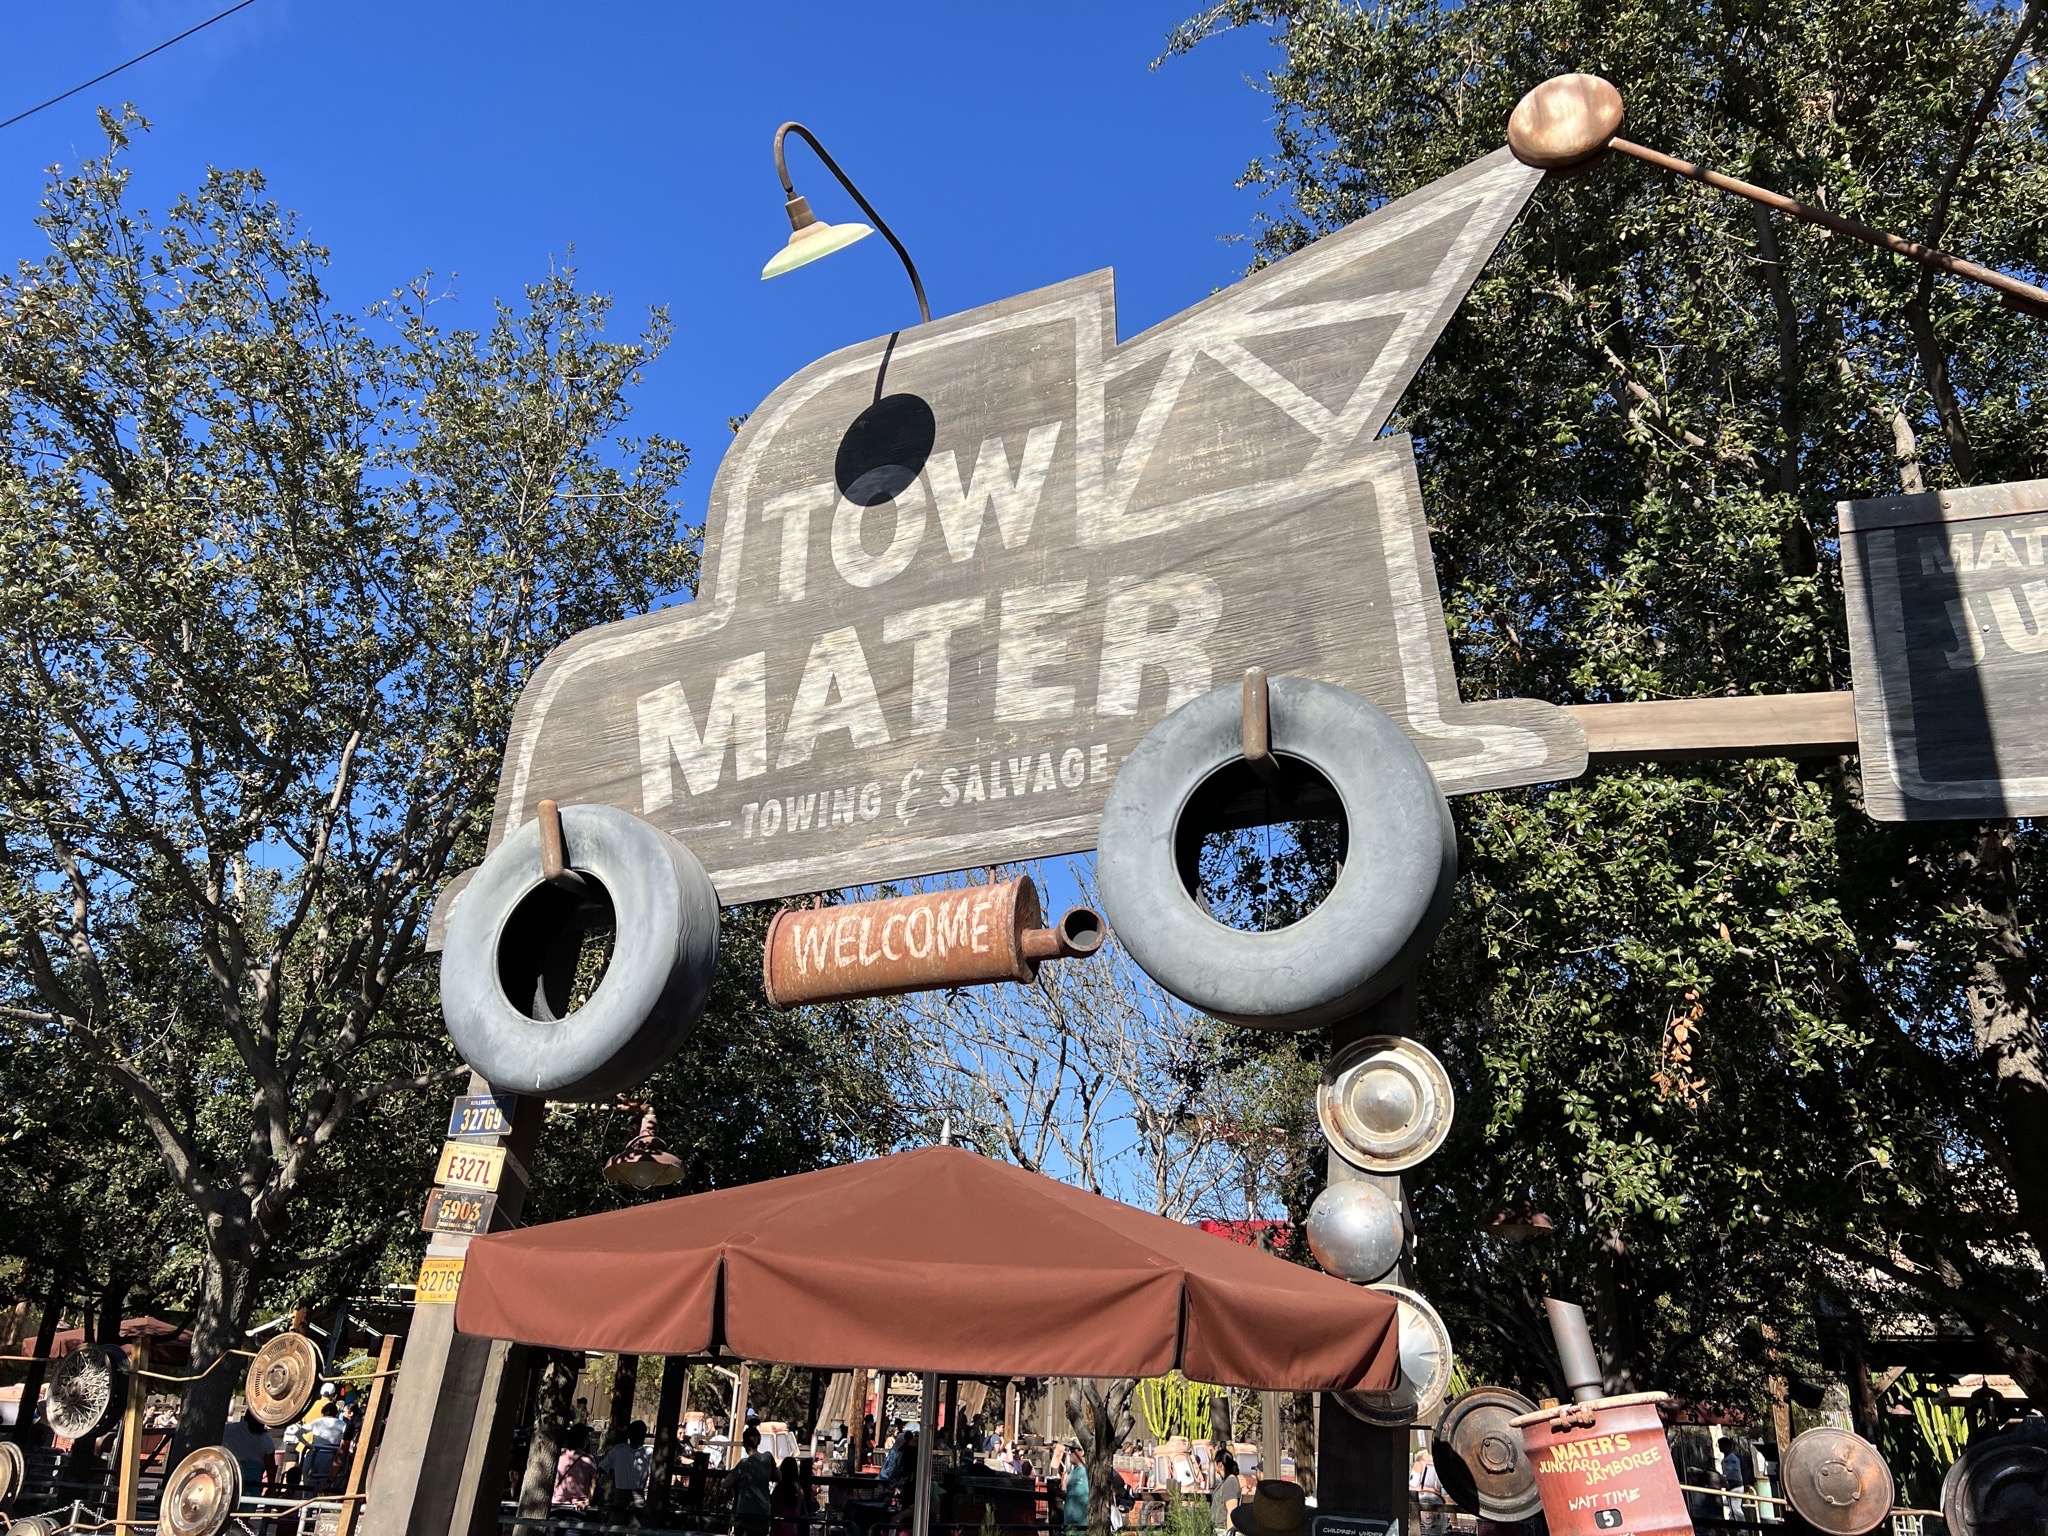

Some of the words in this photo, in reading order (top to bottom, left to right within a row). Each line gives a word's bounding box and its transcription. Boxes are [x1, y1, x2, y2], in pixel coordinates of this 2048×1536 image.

[761, 420, 1063, 603] TOW
[636, 570, 1223, 815] MATER
[741, 781, 883, 840] TOWING
[894, 761, 927, 826] &
[939, 743, 1109, 808] SALVAGE
[793, 897, 992, 975] WELCOME
[460, 1107, 503, 1131] 32769
[447, 1155, 491, 1185] E327L
[439, 1199, 482, 1222] 5903
[1549, 1433, 1631, 1461] MATER'S
[1539, 1458, 1601, 1474] JUNKYARD
[1585, 1446, 1662, 1486] JAMBOREE
[1568, 1493, 1599, 1511] WAIT
[1602, 1488, 1641, 1506] TIME
[1322, 1527, 1356, 1535] CHILDREN
[1602, 1510, 1614, 1527] 5
